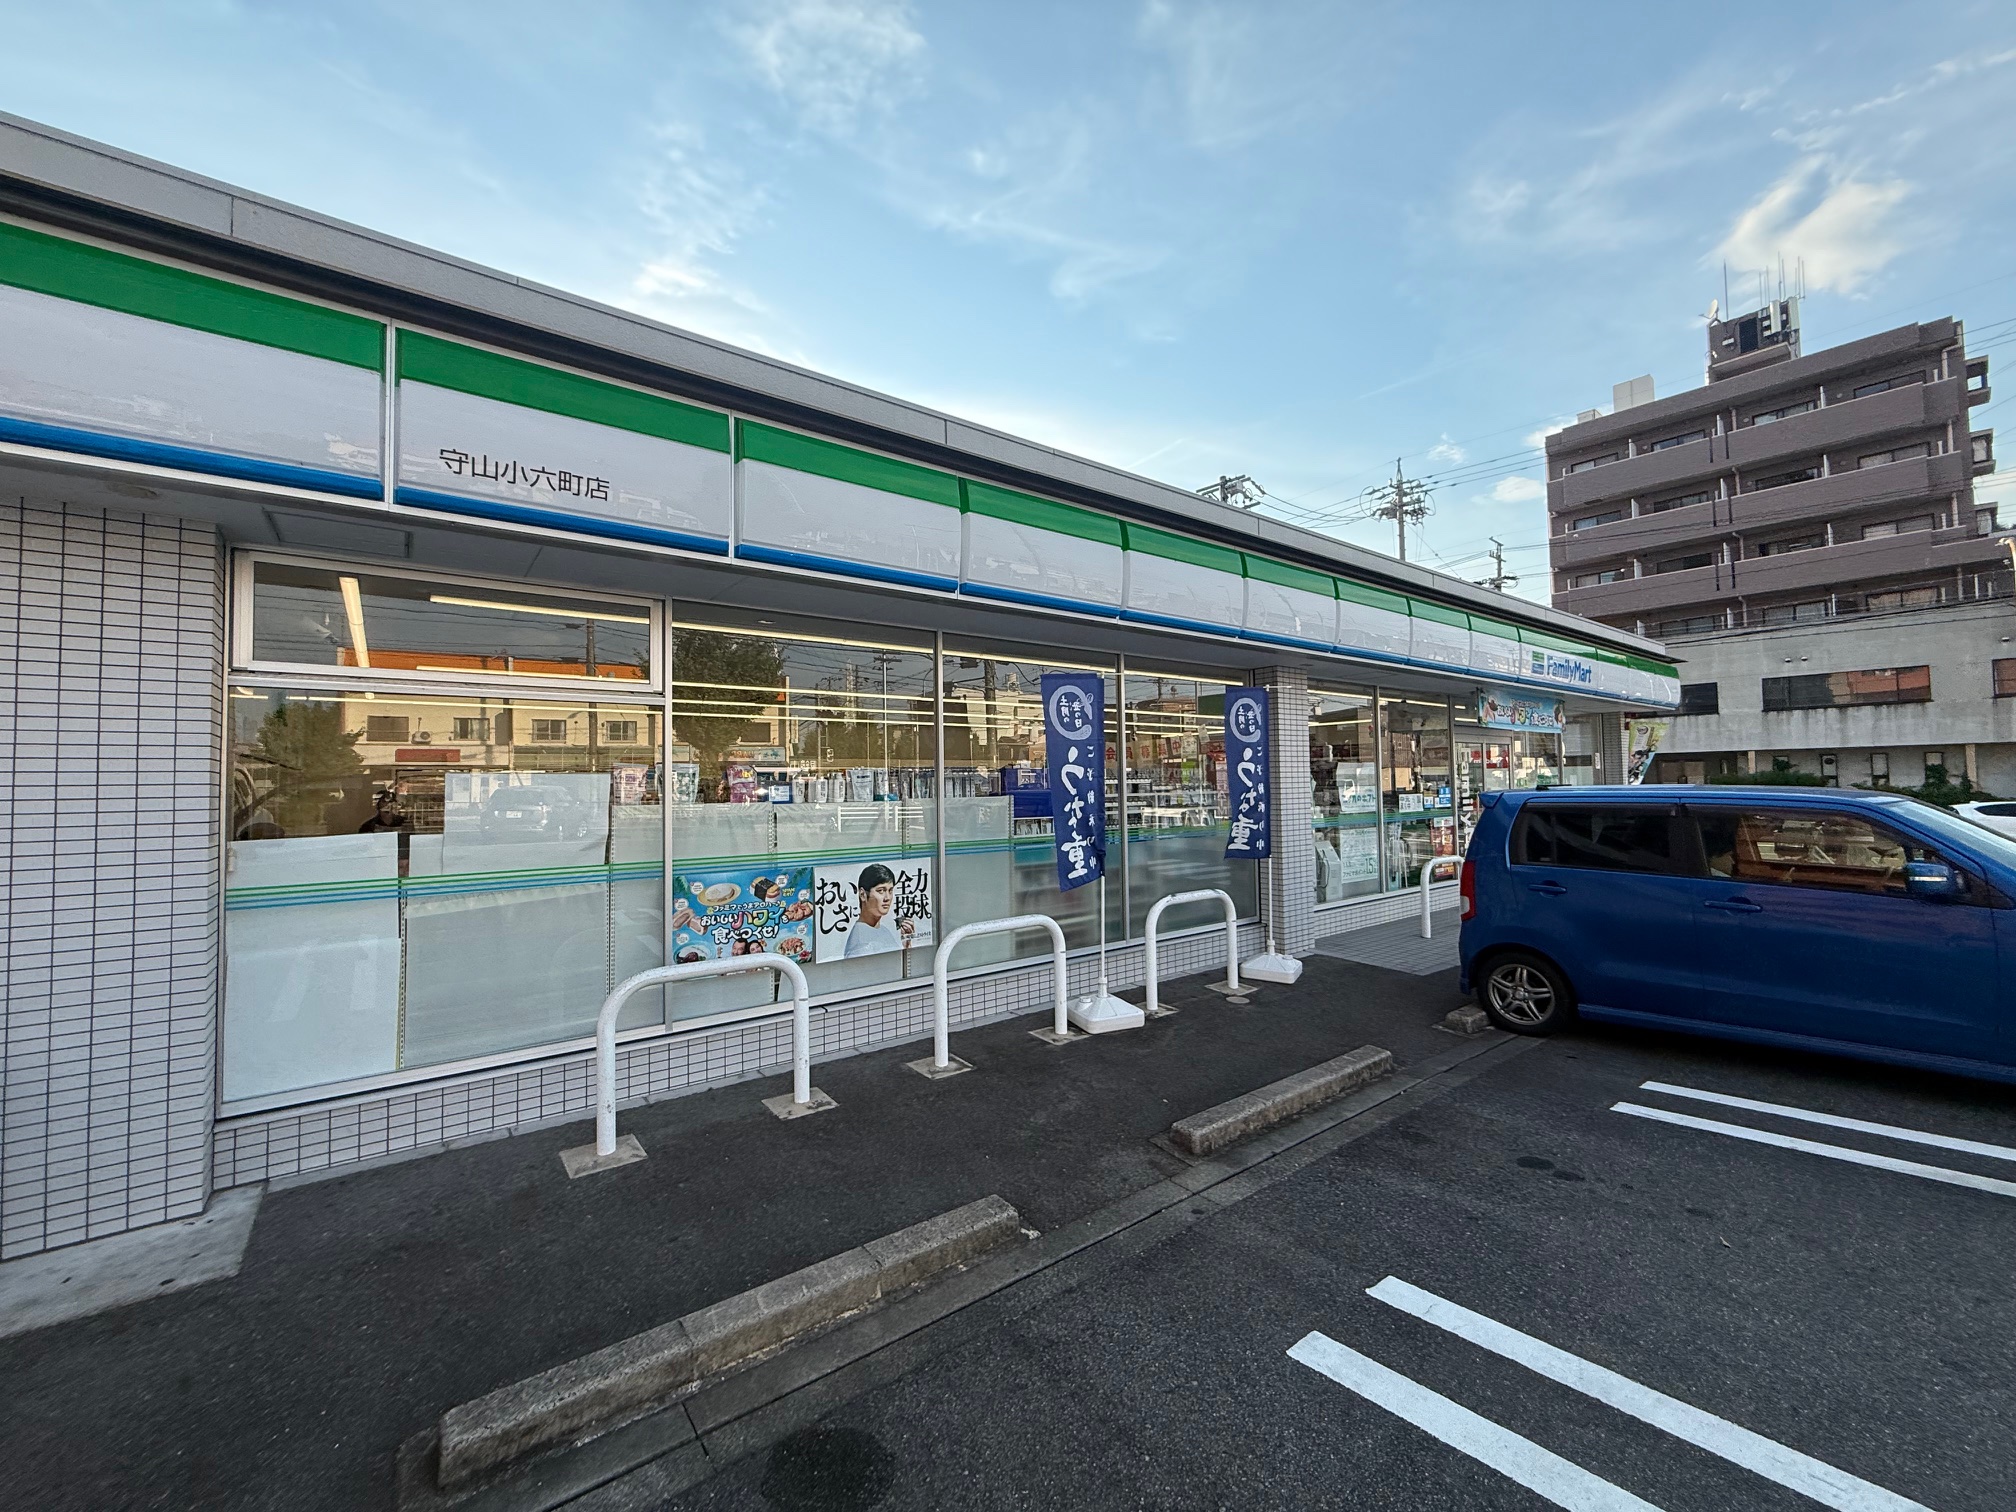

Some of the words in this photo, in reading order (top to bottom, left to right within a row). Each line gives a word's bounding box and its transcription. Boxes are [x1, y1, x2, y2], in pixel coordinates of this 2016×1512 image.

[439, 448, 610, 502] 守山小六町店
[1546, 654, 1592, 684] FamilyMart
[815, 877, 858, 907] おい
[893, 867, 929, 896] 全力
[700, 907, 789, 929] おいしいハワイを
[818, 902, 860, 935] しさに
[711, 925, 779, 944] 食べつくせ!
